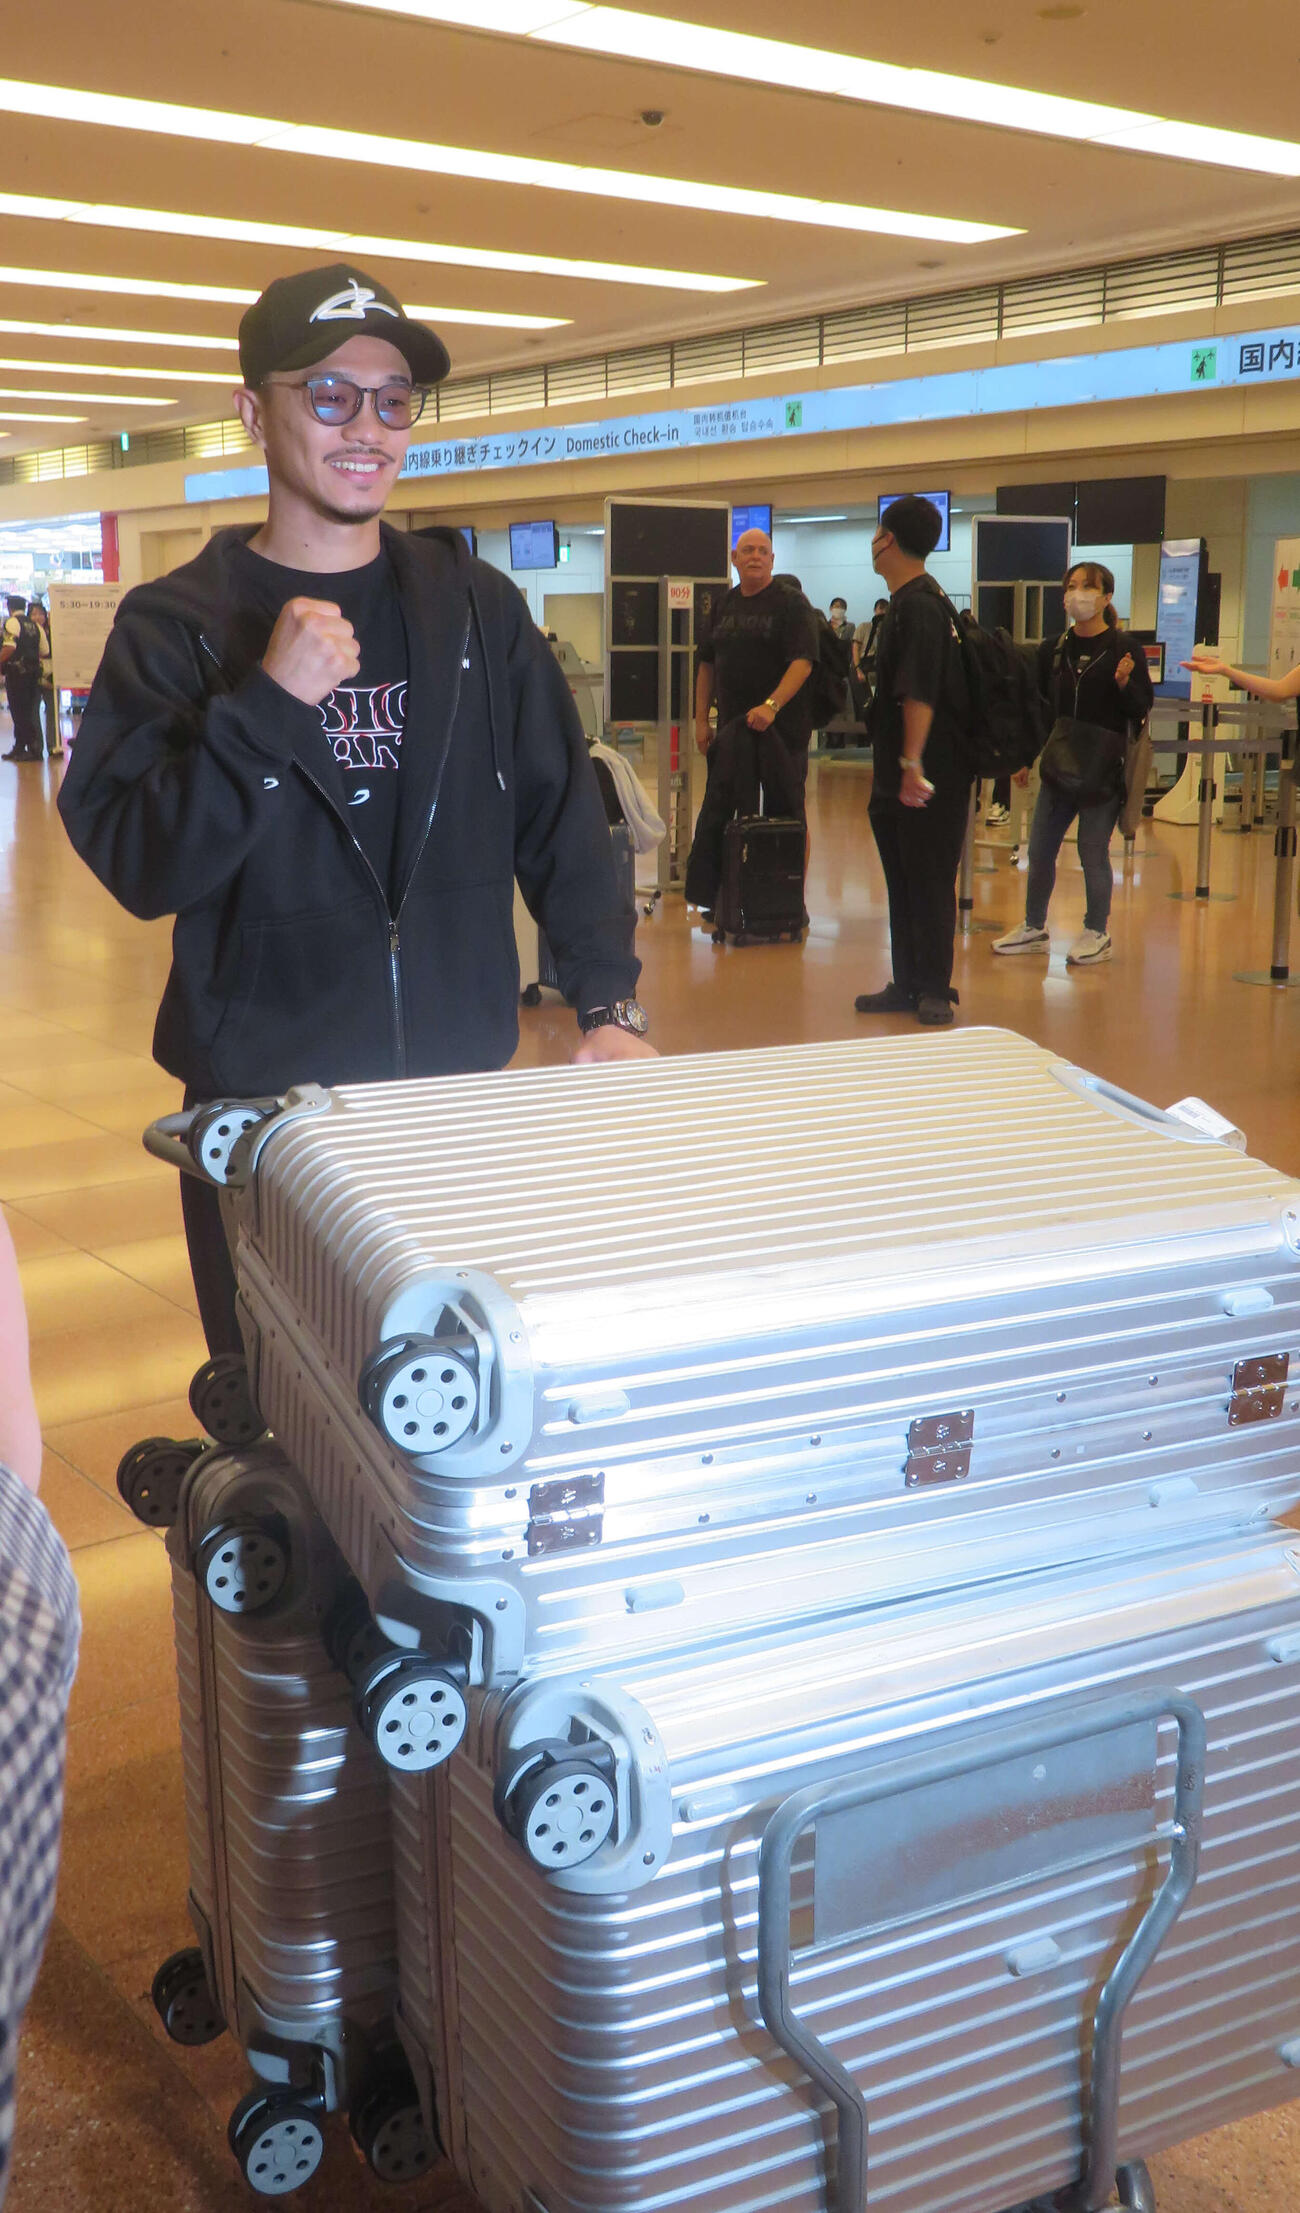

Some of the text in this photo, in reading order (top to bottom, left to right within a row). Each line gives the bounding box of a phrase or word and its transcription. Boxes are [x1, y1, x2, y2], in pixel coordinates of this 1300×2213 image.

[1239, 338, 1300, 375] 国内
[566, 423, 680, 454] Domestic Check-in
